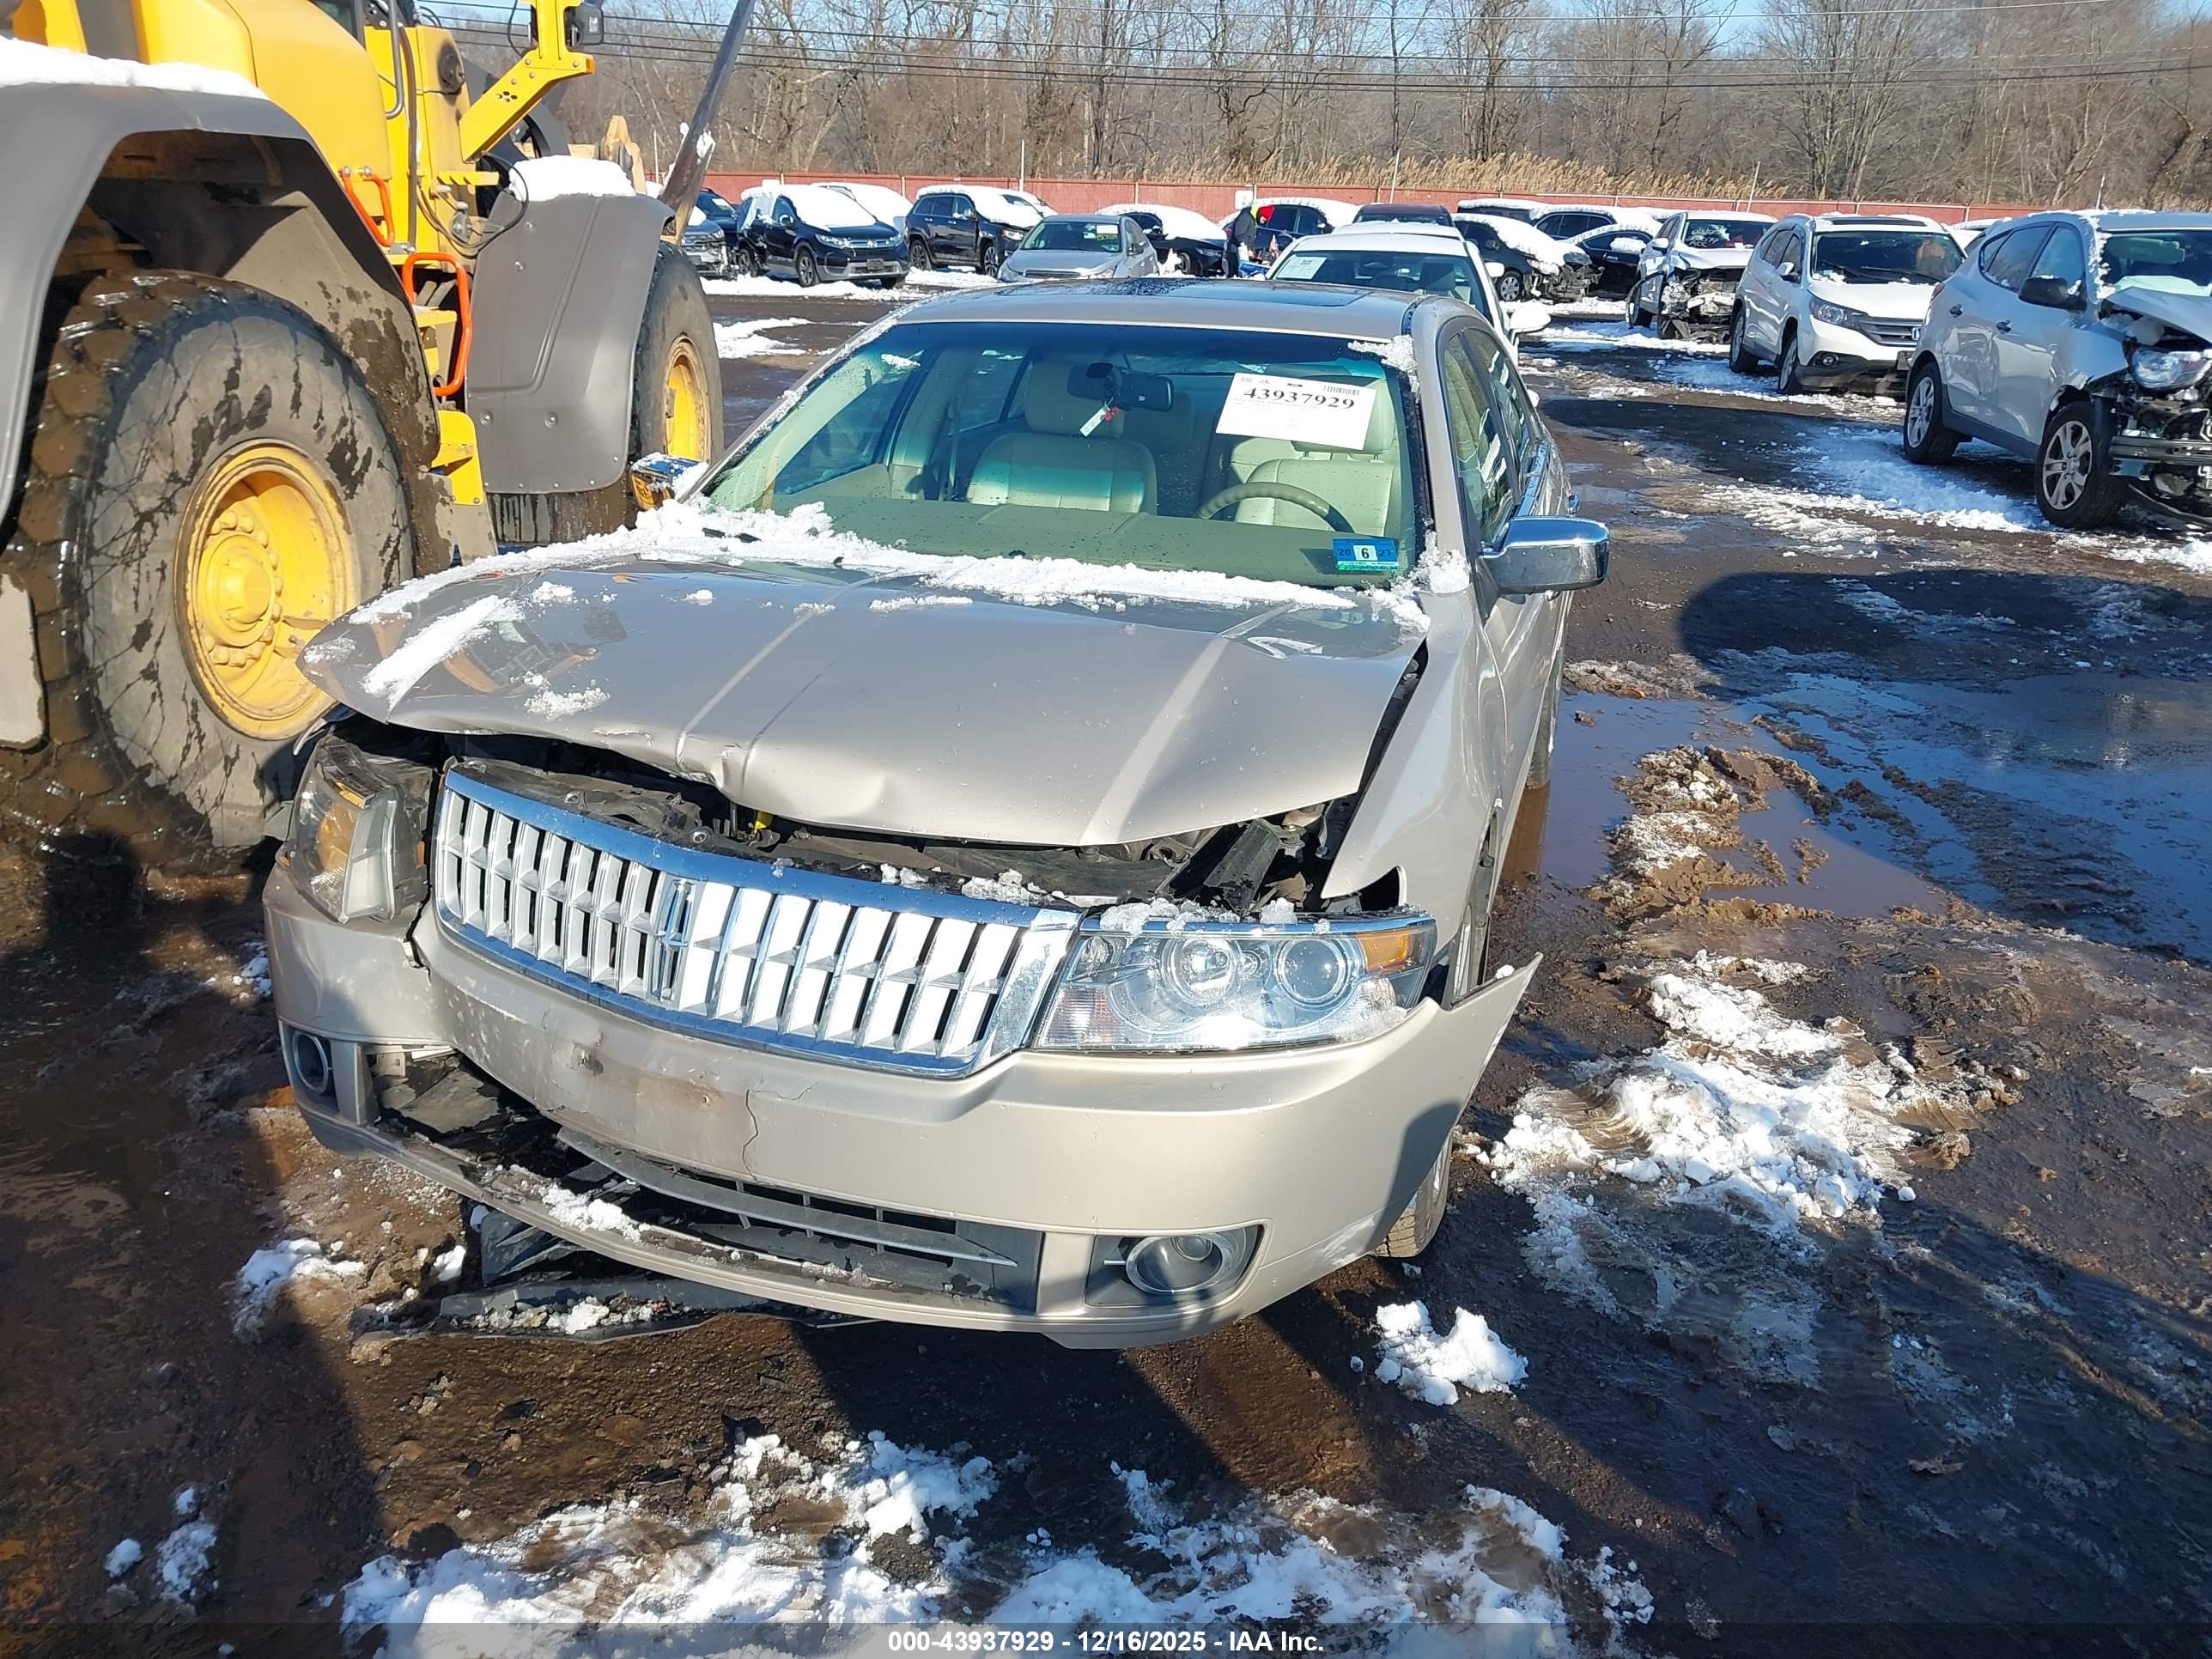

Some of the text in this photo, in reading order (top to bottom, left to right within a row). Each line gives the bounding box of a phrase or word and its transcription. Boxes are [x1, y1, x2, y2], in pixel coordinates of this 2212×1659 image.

[1243, 386, 1355, 410] 43937929
[1338, 548, 1352, 556] 20
[1360, 547, 1370, 559] 6
